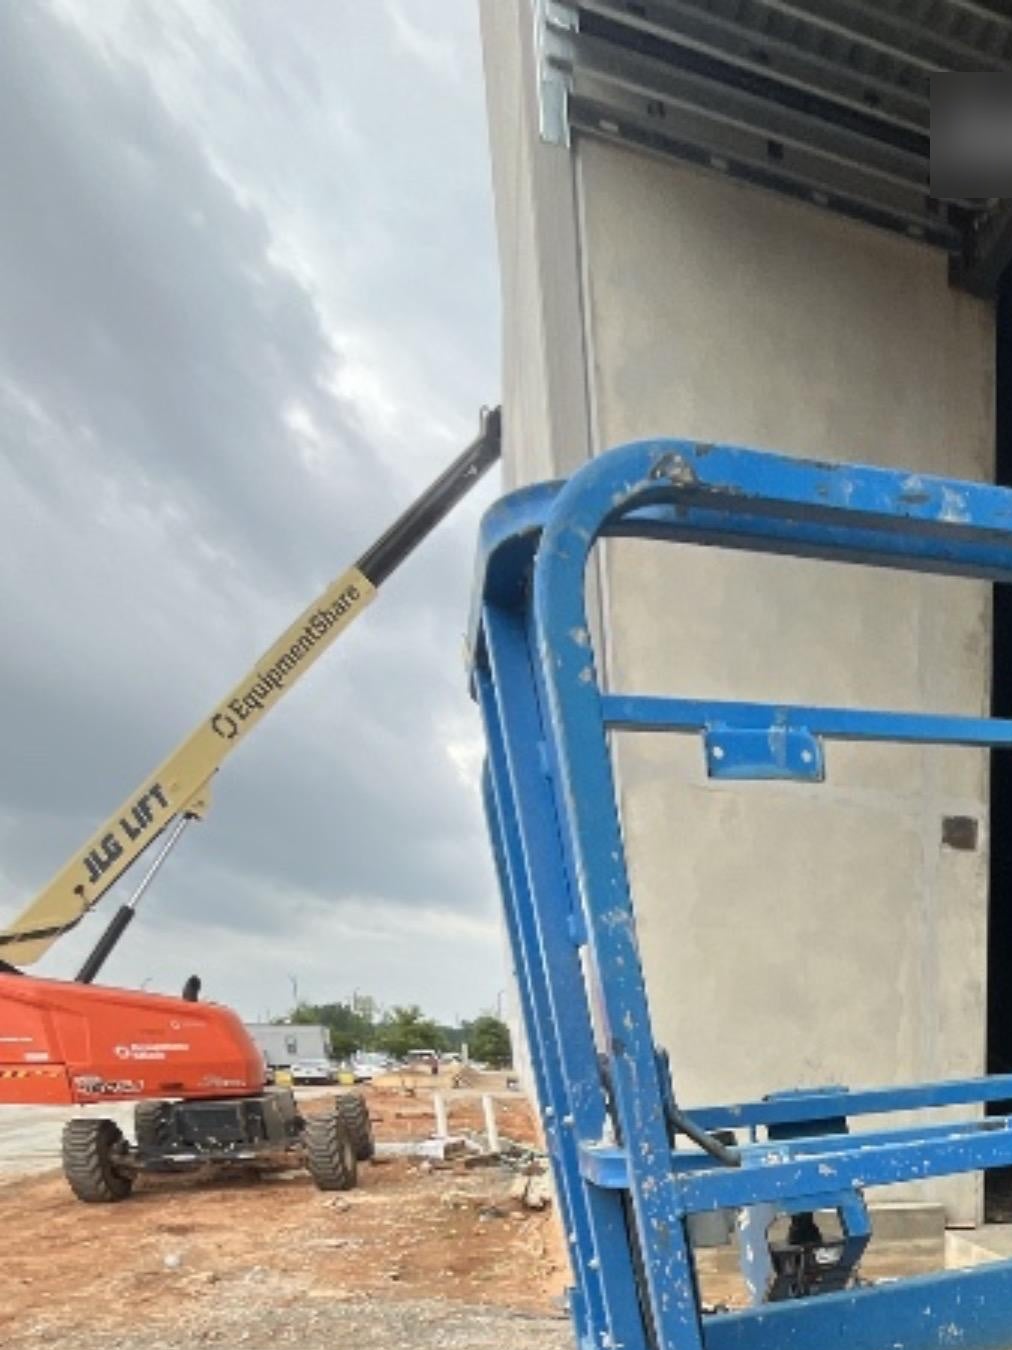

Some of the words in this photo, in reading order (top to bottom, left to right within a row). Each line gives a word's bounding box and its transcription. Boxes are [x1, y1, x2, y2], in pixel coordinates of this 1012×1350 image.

[227, 584, 361, 721] EquipmentShare
[83, 833, 124, 883] JLG
[120, 783, 169, 841] LIFT
